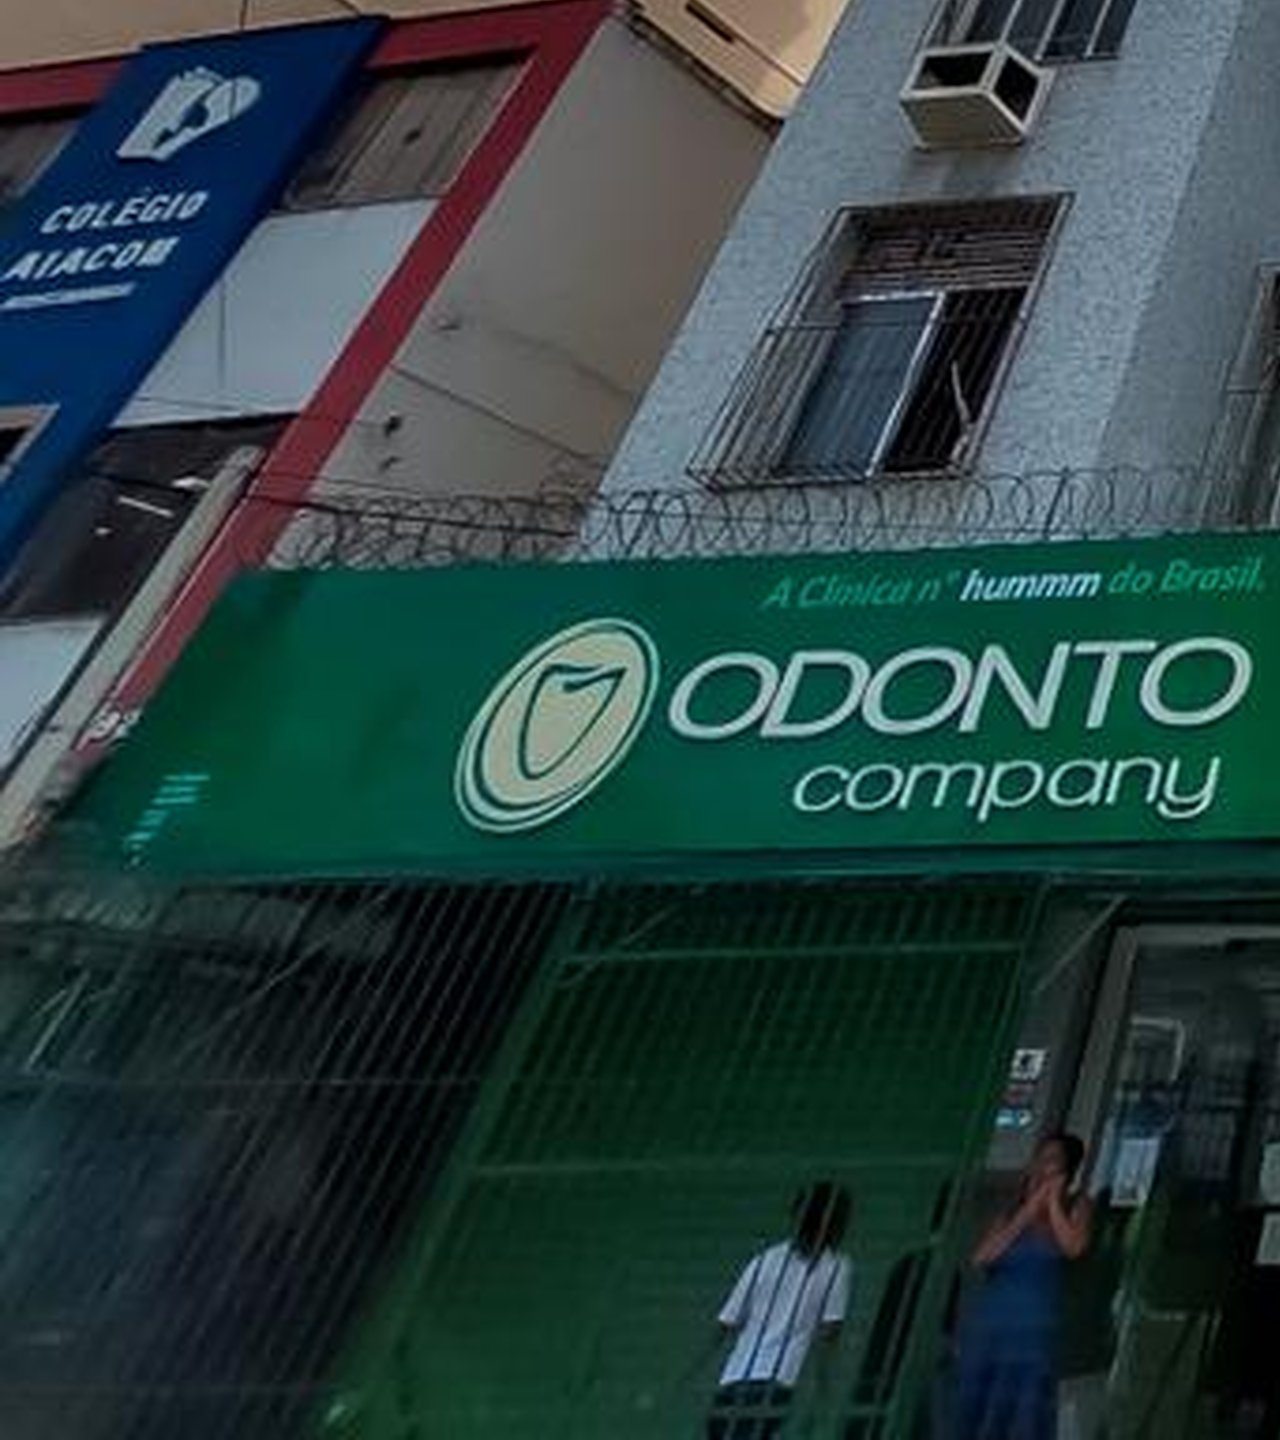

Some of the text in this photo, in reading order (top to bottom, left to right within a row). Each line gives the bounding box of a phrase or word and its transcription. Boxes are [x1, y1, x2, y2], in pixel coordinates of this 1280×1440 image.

[763, 576, 793, 608] A
[959, 569, 1102, 601] hummm
[1107, 562, 1152, 594] do
[668, 637, 1253, 738] ODONTO
[793, 756, 1220, 822] company
